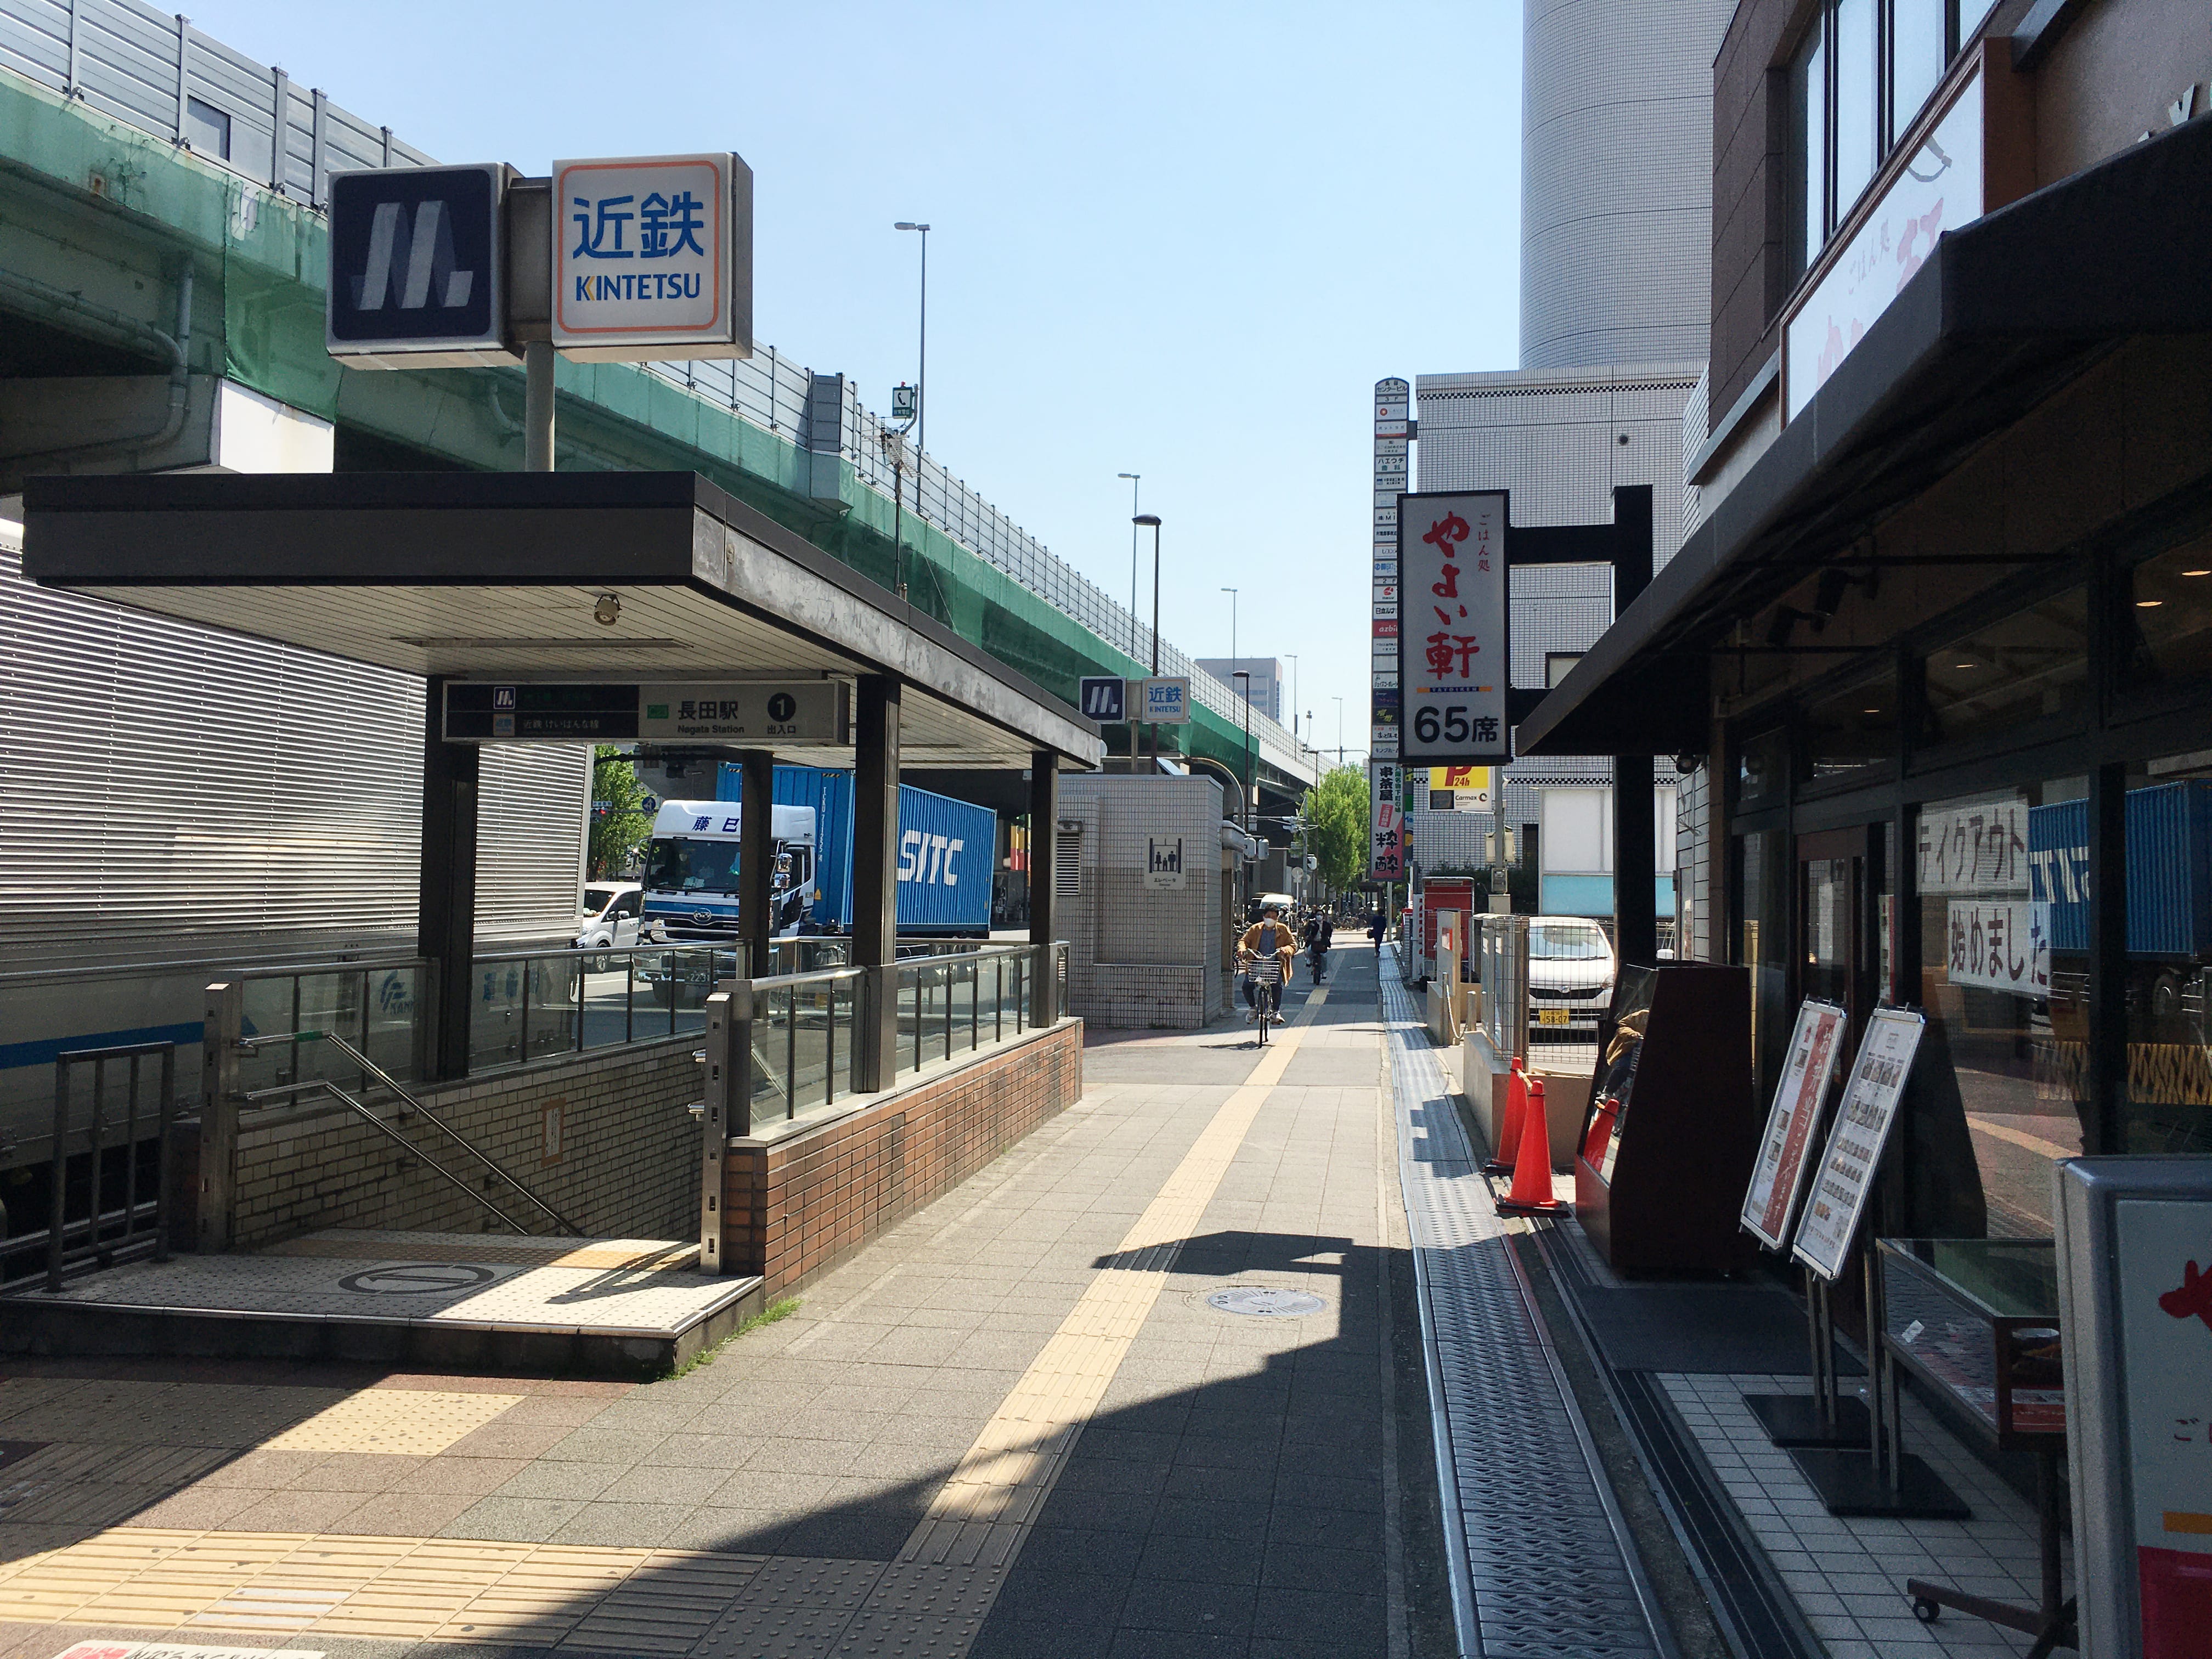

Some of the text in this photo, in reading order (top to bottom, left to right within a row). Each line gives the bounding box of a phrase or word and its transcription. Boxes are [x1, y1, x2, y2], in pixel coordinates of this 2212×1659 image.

[573, 191, 704, 259] 近鉄
[575, 273, 700, 301] KINTETSU
[1478, 514, 1491, 572] ごはん処
[1423, 511, 1480, 681] やよい軒
[678, 701, 738, 720] 長田駅
[1148, 686, 1182, 703] 近鉄
[678, 725, 744, 735] Nagata Station
[767, 725, 796, 734] 出入口
[1414, 706, 1499, 743] 65席
[1379, 766, 1393, 801] 串茶屋
[1454, 777, 1470, 786] 24h
[898, 829, 965, 886] SITC
[1919, 808, 2024, 884] テイクアウト
[1951, 907, 2048, 985] 始めました
